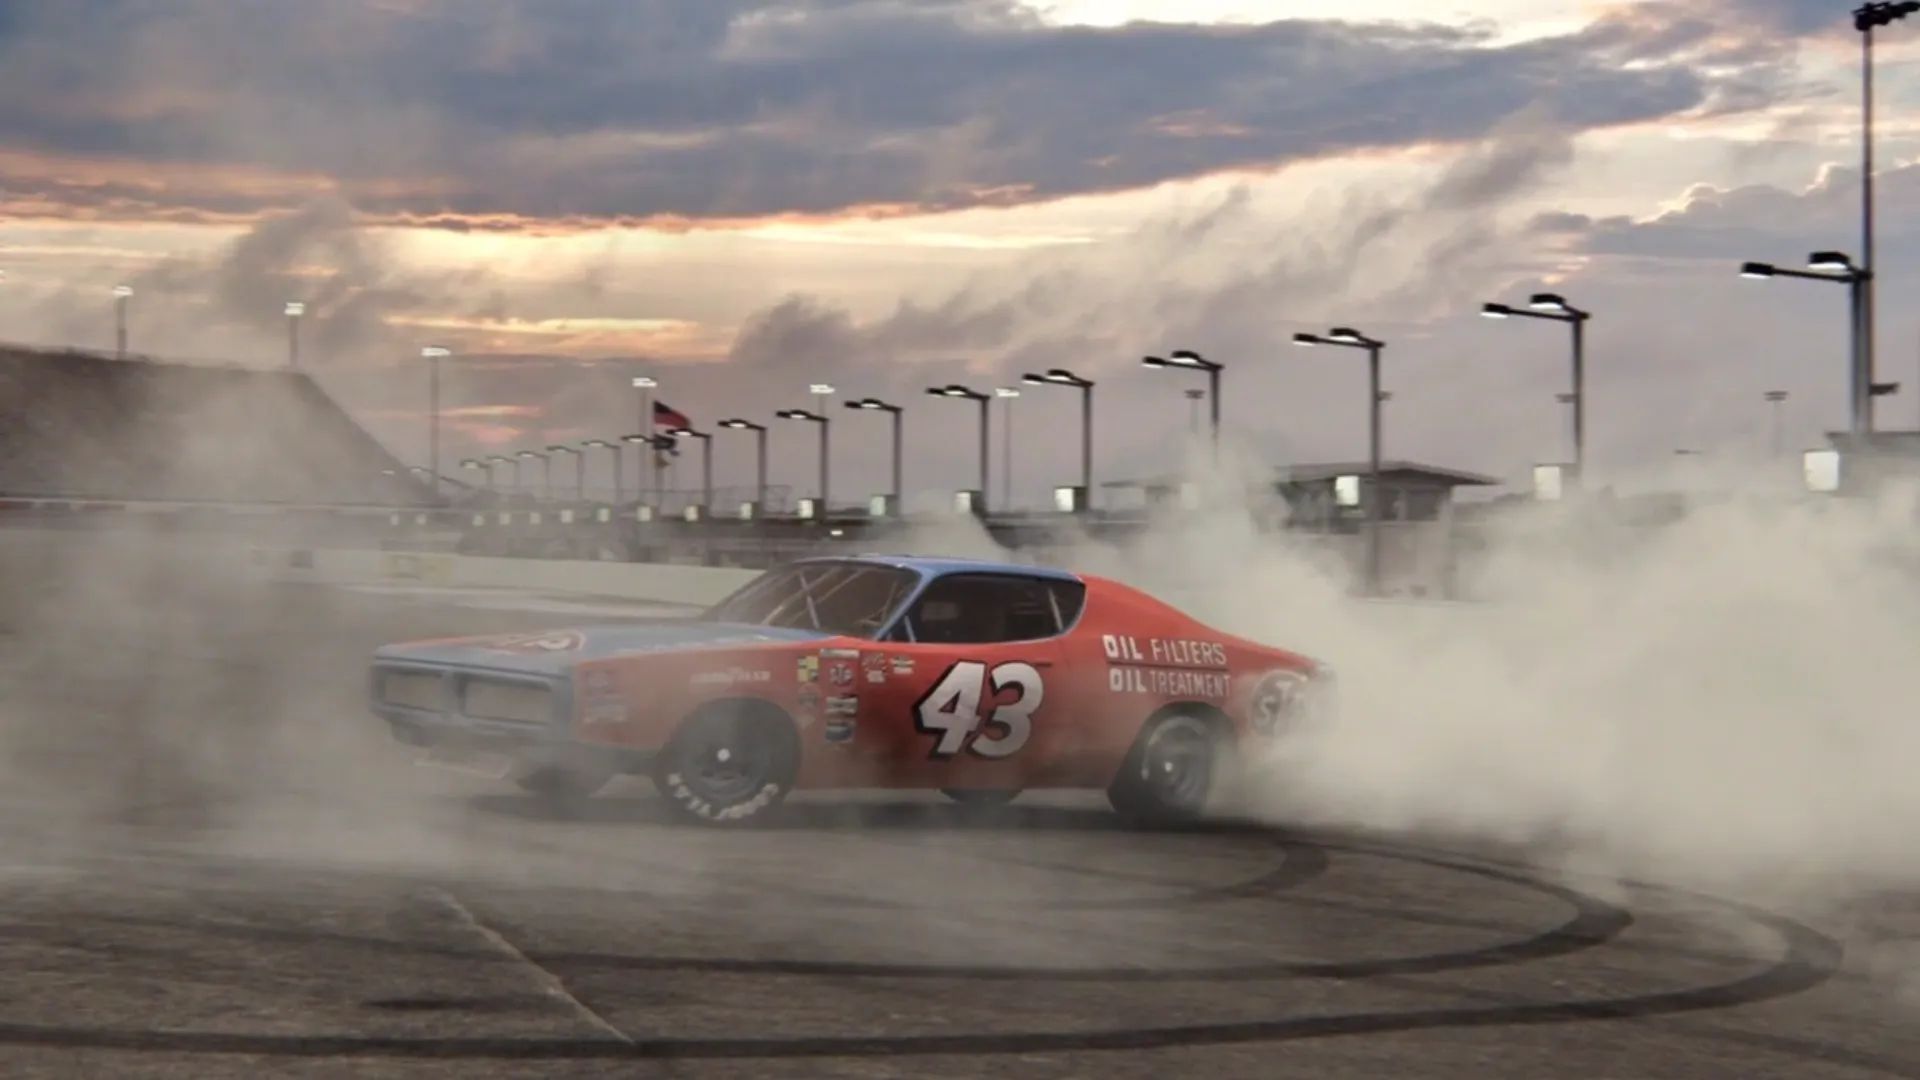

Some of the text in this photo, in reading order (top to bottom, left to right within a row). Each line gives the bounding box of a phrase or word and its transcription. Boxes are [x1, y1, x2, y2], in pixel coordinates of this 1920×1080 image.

[1102, 634, 1227, 665] OIL FILTERS
[1109, 668, 1231, 697] OIL TREATMENT
[916, 660, 1044, 758] 43
